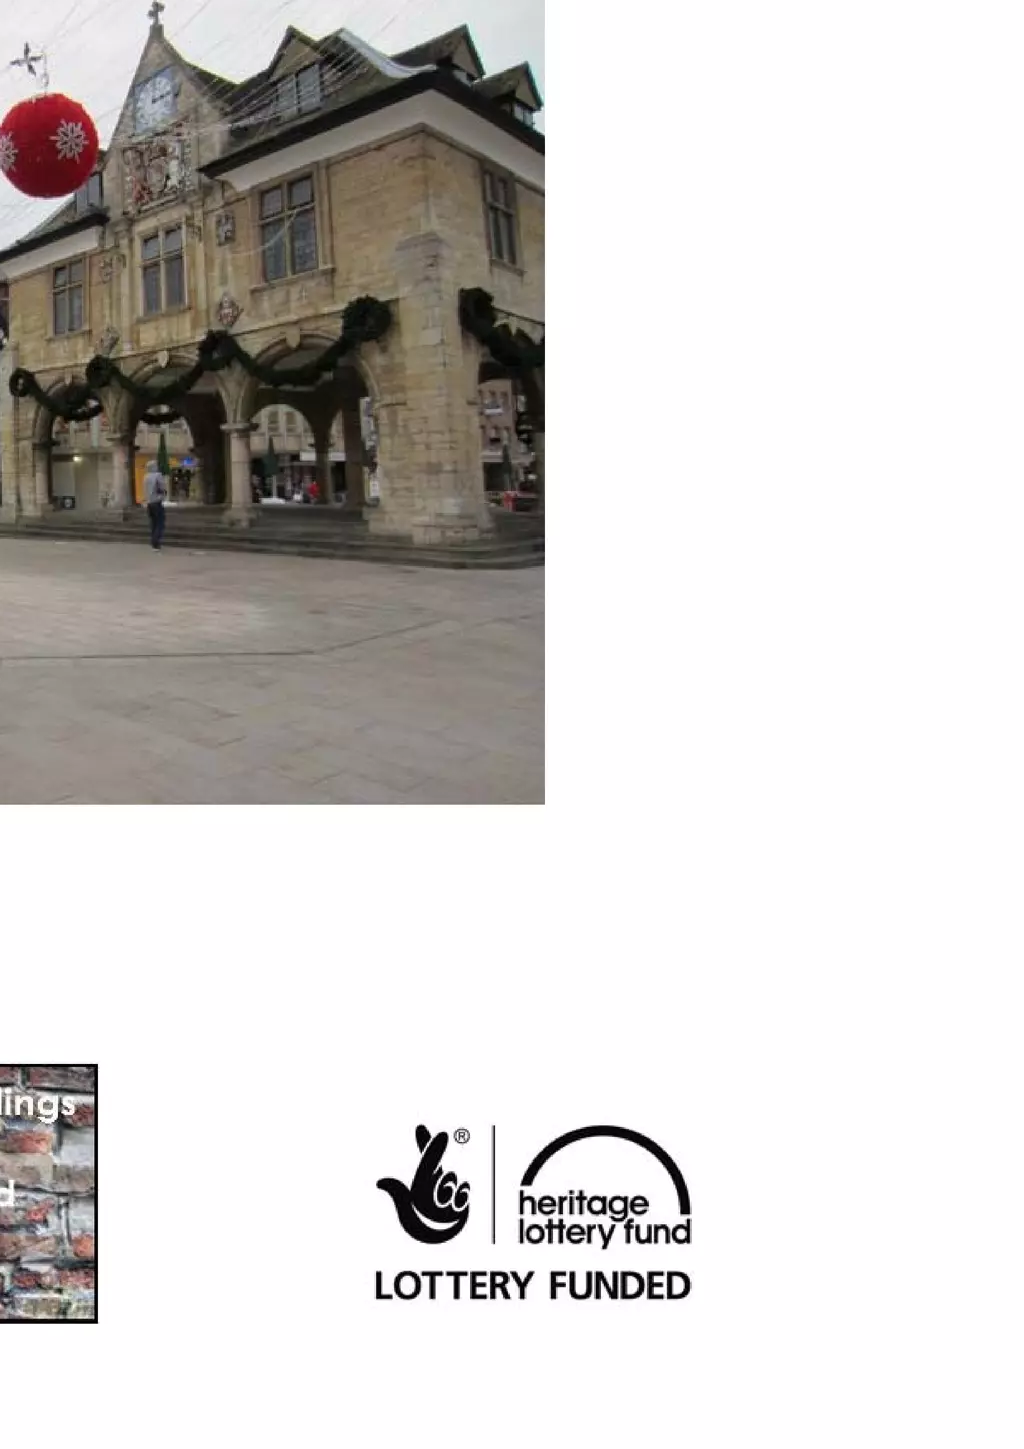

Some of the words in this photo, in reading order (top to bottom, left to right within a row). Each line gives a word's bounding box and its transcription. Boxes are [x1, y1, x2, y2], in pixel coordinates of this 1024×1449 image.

[519, 1190, 650, 1222] heritage
[519, 1218, 616, 1250] lottery
[625, 1218, 692, 1244] fund
[375, 1271, 535, 1300] LOTTERY
[550, 1271, 692, 1300] FUNDED
